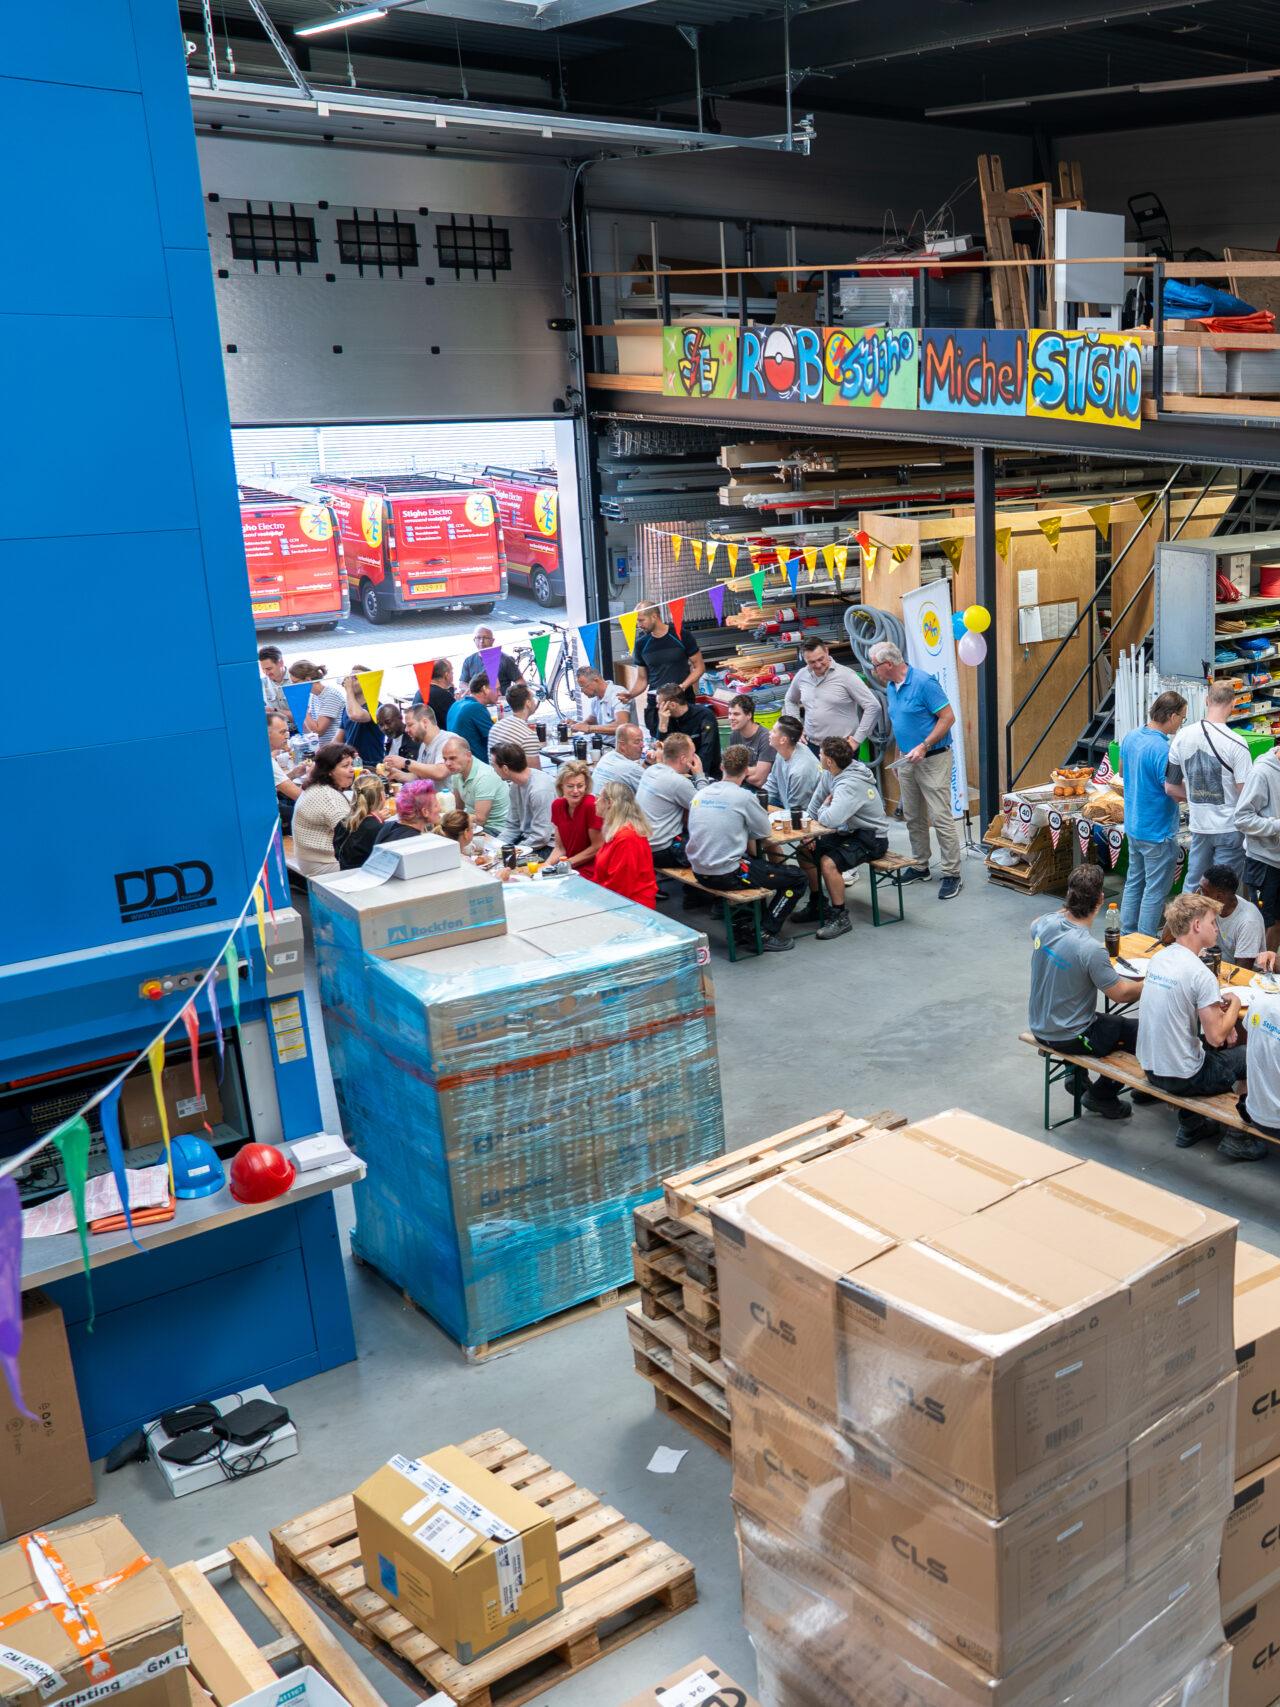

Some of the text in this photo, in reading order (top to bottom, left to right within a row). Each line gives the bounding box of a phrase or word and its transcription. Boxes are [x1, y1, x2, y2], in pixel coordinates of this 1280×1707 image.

[923, 338, 1024, 405] Michel
[402, 508, 453, 519] Stigho Electro
[258, 522, 286, 531] Electro
[1021, 808, 1030, 817] 40
[1050, 815, 1060, 825] 40
[1079, 825, 1089, 833] 40
[1110, 834, 1120, 844] 40
[114, 860, 214, 914] DDD
[410, 918, 464, 938] Rockfon
[750, 1301, 797, 1346] CLS
[889, 1376, 946, 1425] CLS
[890, 1534, 949, 1584] CLS
[147, 1655, 171, 1673] GM
